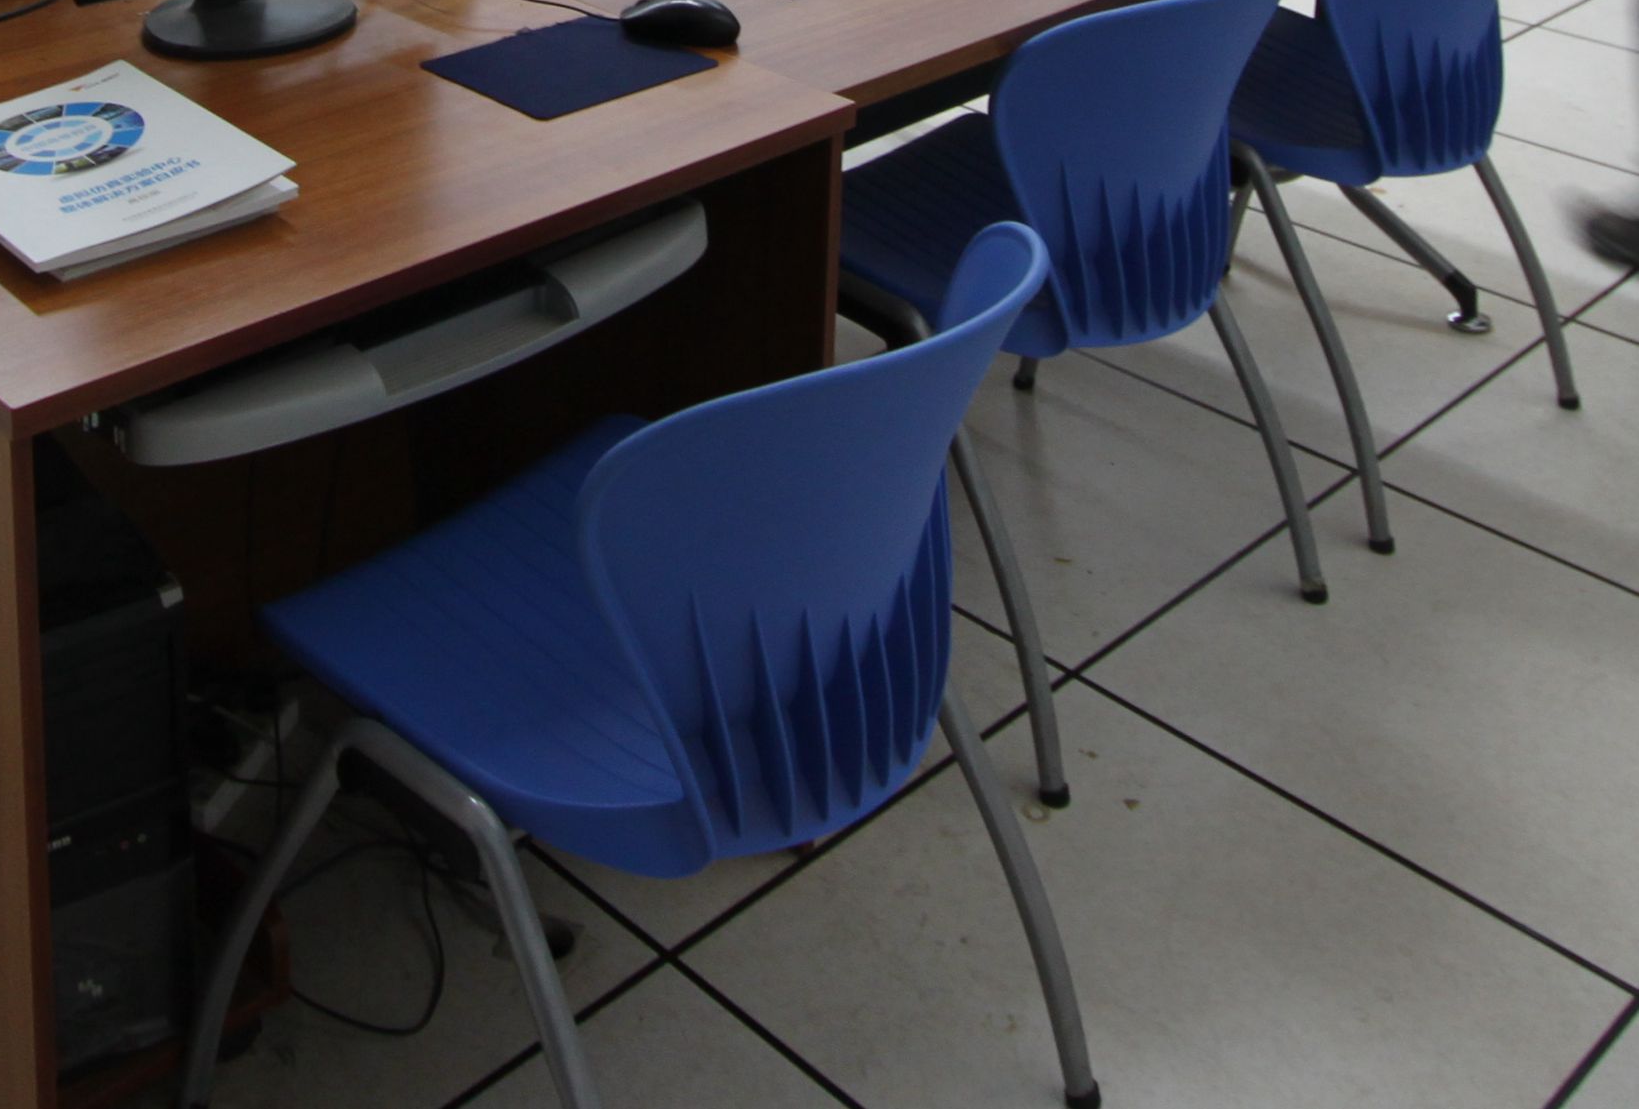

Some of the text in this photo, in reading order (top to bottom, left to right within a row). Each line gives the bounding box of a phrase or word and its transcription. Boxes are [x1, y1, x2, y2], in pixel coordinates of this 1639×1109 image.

[59, 157, 182, 204] 虚拟仿真实验中心
[59, 159, 201, 213] 整体解决方案白皮书
